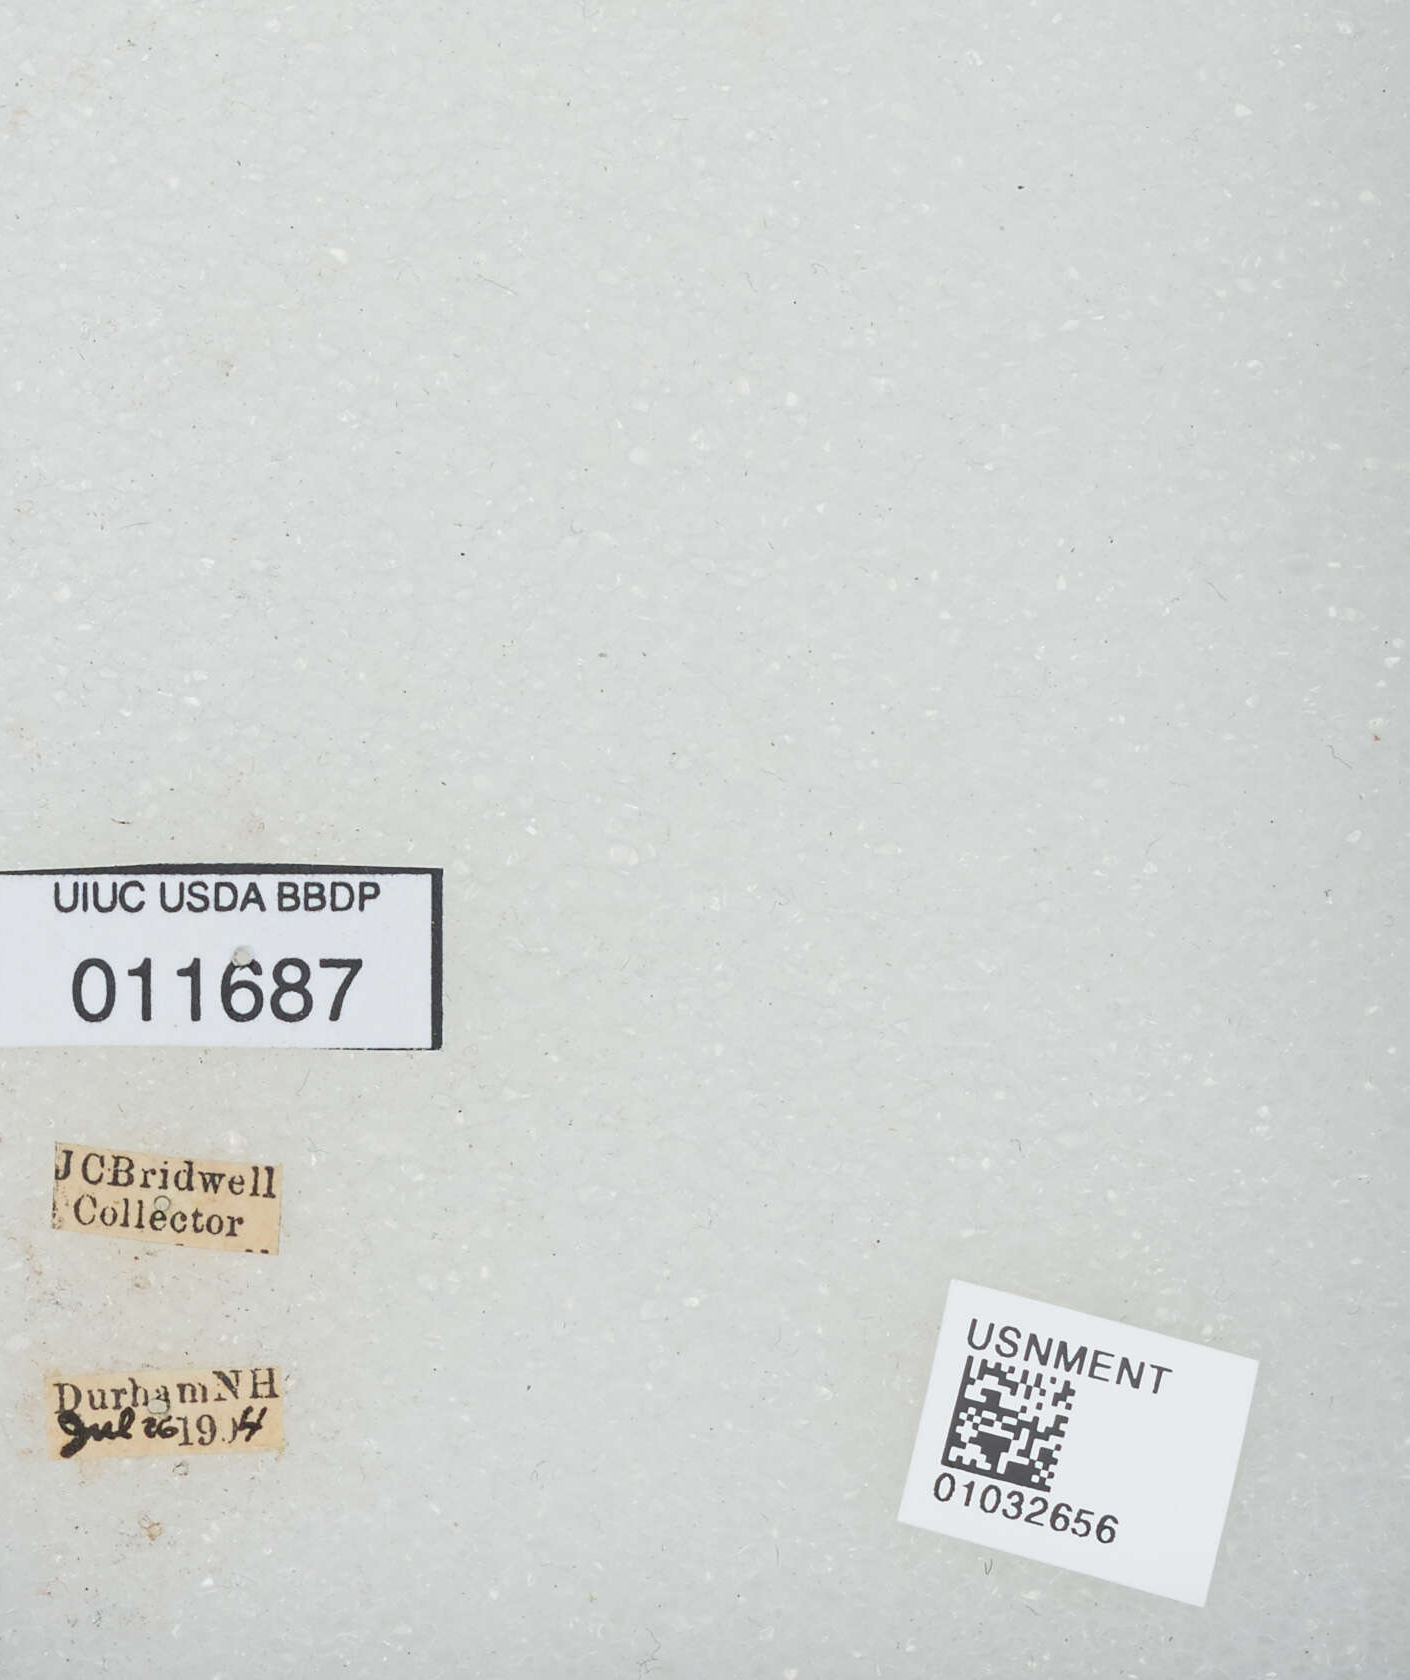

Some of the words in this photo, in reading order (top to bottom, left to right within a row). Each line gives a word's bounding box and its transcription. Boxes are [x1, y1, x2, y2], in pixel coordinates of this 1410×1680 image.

[54, 881, 146, 913] UIUC
[159, 881, 267, 913] USDA
[277, 881, 382, 912] BBDP
[71, 956, 363, 1023] 011687
[73, 1194, 245, 1238] Collector
[967, 1318, 1173, 1395] USNMENT
[933, 1472, 1119, 1544] 01032656
